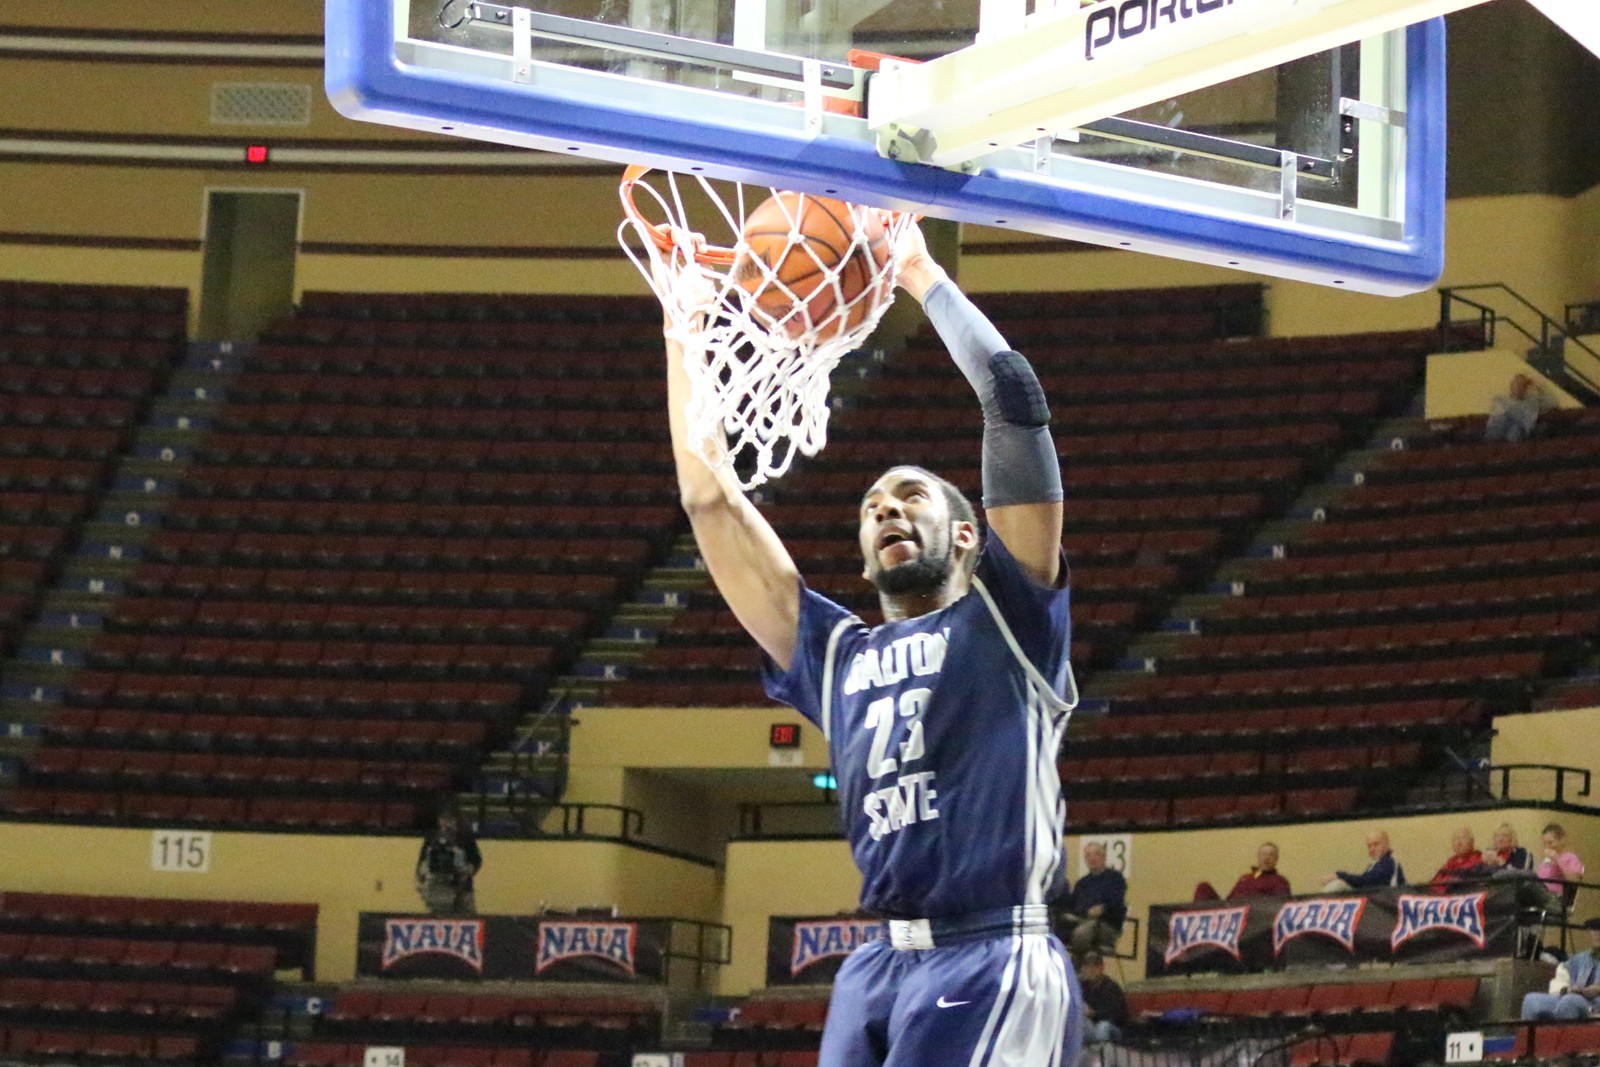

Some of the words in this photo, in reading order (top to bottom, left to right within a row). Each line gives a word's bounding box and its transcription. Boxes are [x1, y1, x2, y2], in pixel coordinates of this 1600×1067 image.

[864, 687, 934, 780] 23
[863, 770, 940, 842] STATE
[160, 835, 204, 869] 115
[388, 921, 480, 961] NAIA
[1169, 909, 1245, 952] NAIA
[1275, 901, 1358, 946] NAIA
[1393, 896, 1483, 944] NAIA
[541, 925, 632, 965] NAIA
